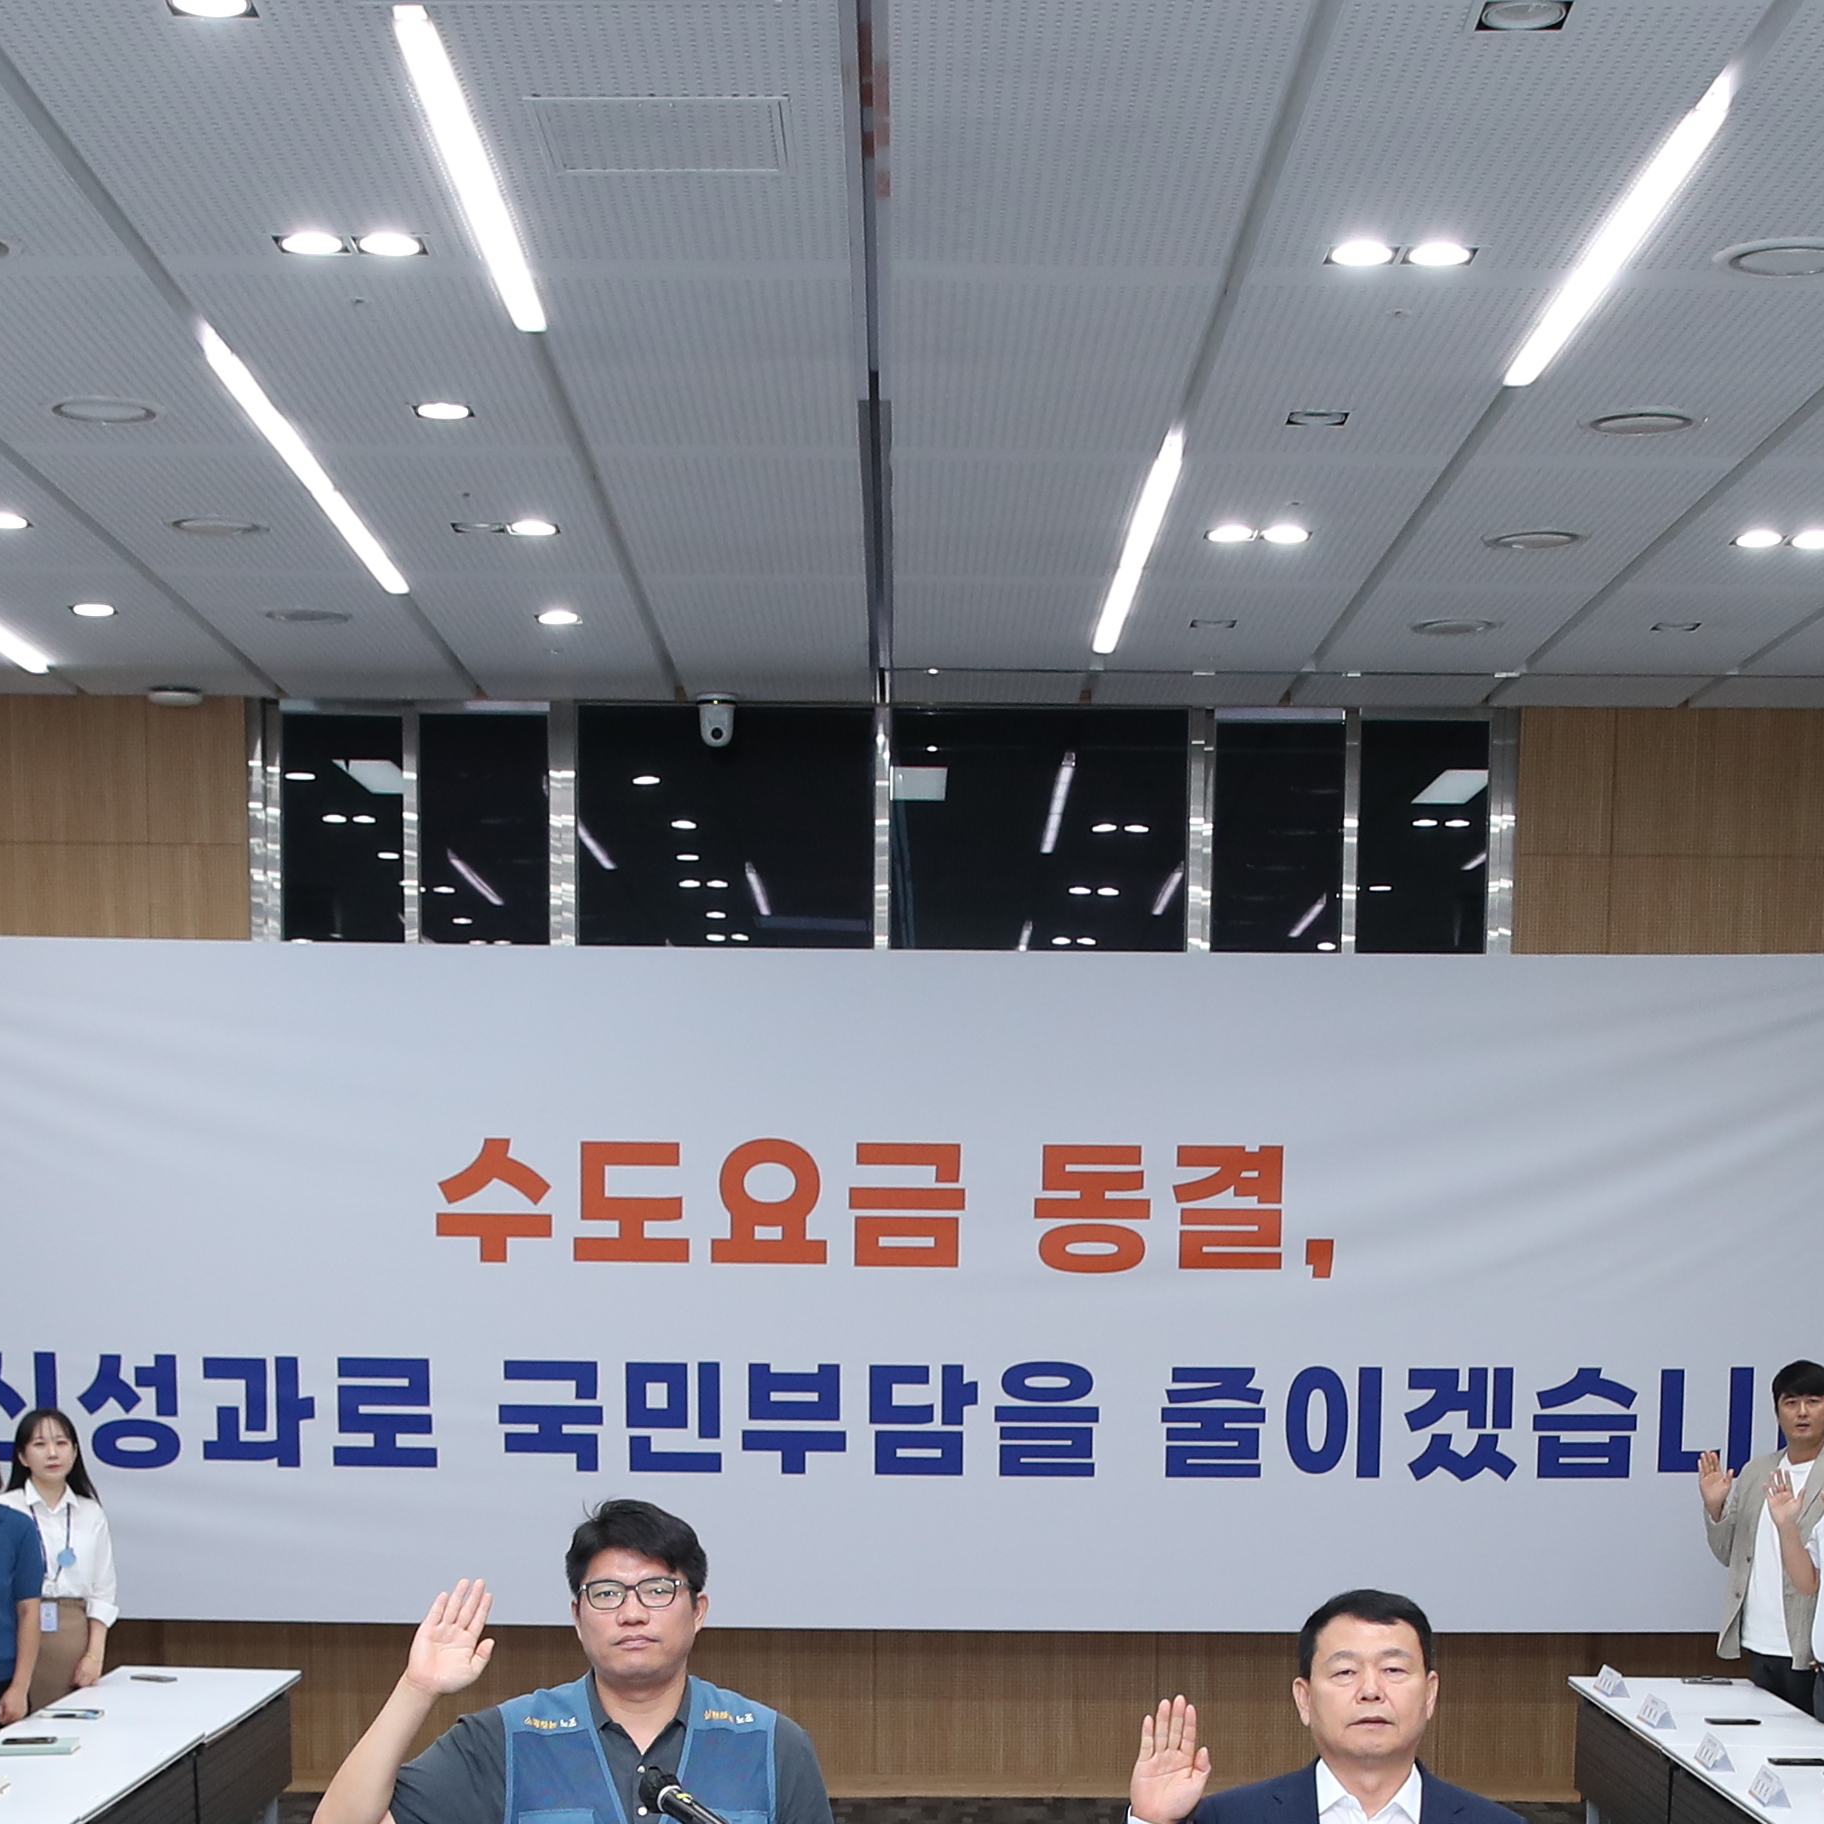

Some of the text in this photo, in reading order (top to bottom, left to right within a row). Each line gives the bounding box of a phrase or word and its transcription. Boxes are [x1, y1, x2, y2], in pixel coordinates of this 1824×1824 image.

[436, 1137, 1335, 1279] 수도요금 동결,
[499, 1360, 1100, 1478] 국민부담을
